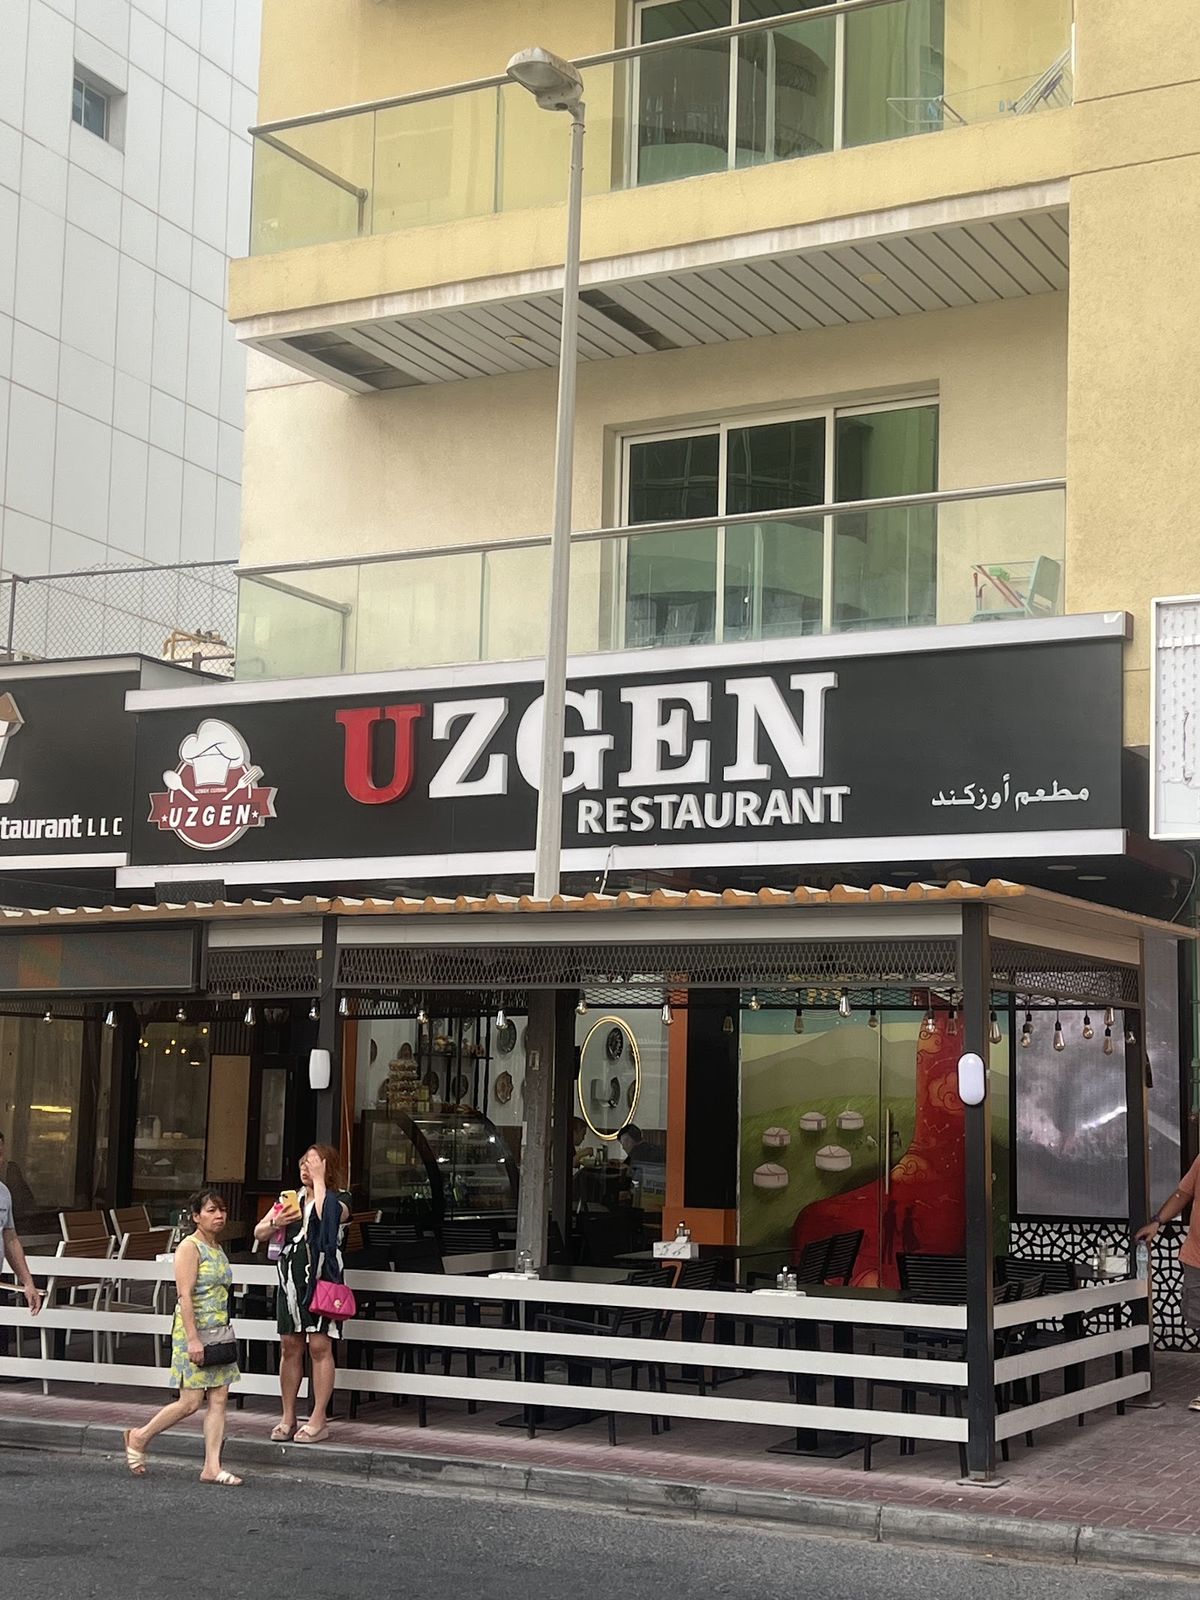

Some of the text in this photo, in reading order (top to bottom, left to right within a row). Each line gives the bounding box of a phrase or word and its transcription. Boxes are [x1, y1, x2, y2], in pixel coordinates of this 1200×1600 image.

[335, 671, 838, 805] UZGEN
[577, 786, 851, 834] RESTAURANT
[931, 773, 1090, 812] مطعم أوزكند
[169, 804, 251, 828] UZGEN
